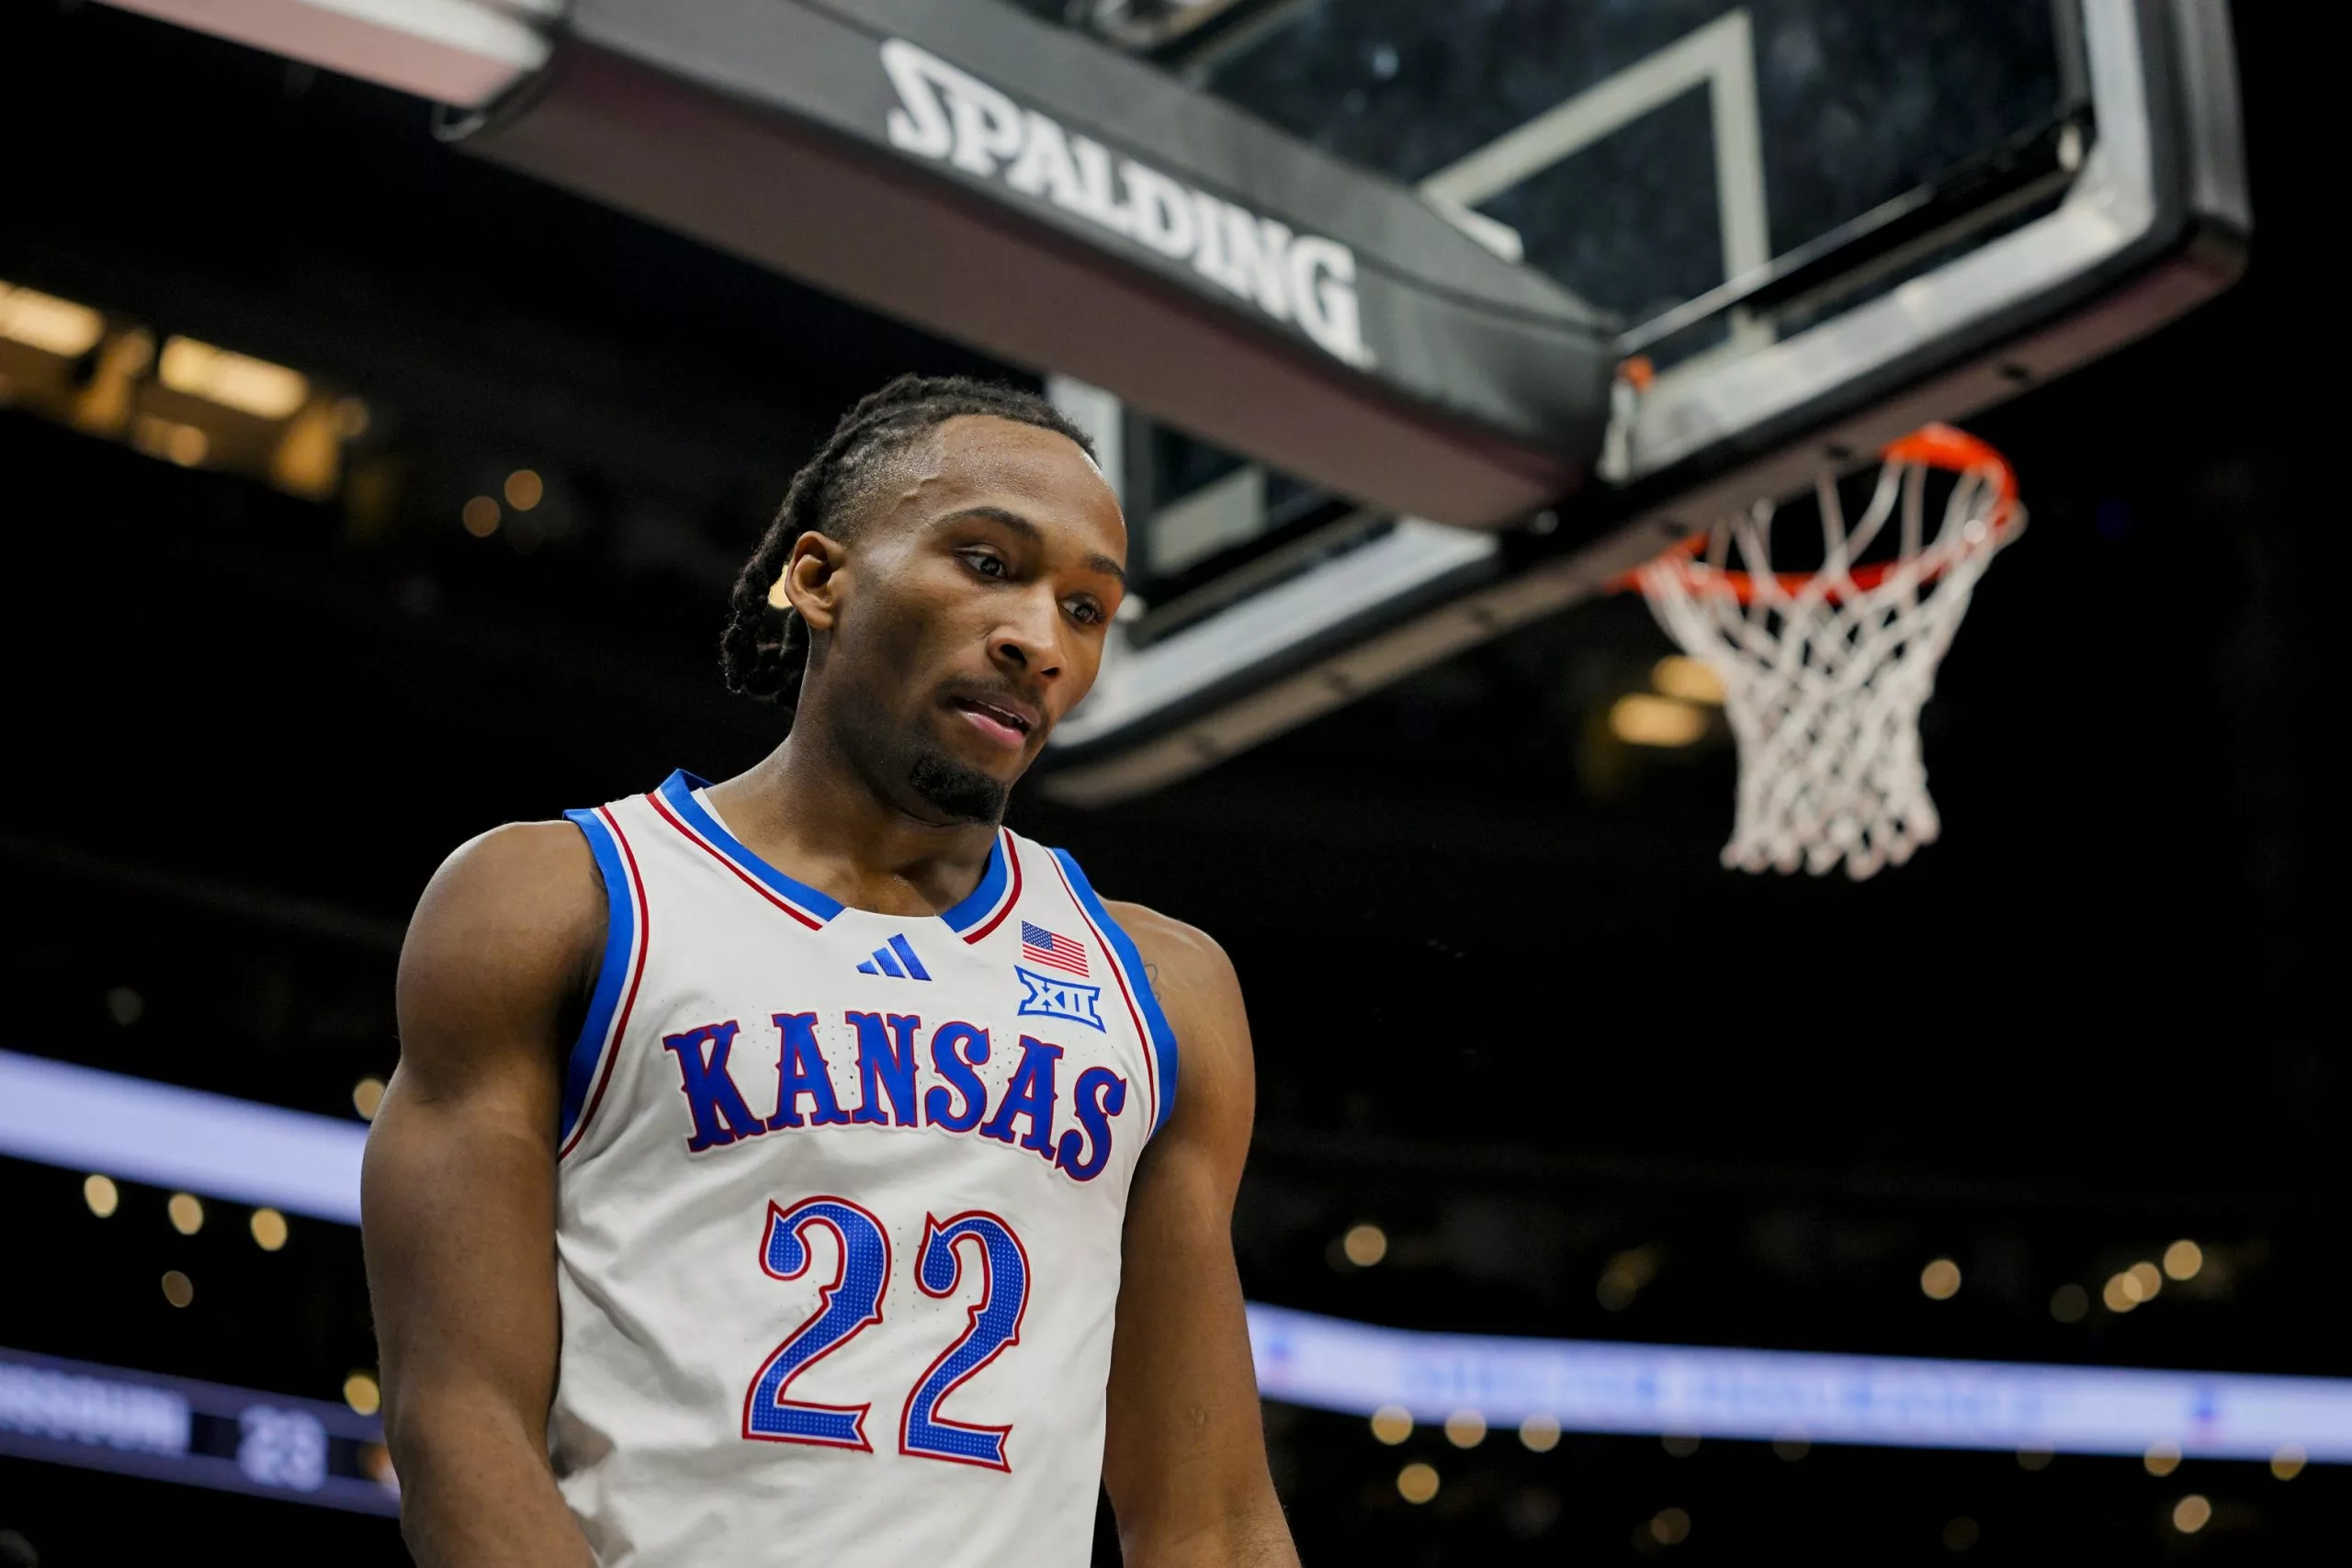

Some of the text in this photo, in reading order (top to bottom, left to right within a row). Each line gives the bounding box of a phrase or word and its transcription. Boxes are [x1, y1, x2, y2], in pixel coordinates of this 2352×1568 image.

[880, 38, 1375, 367] SPALDING
[662, 1011, 1127, 1182] KANSAS
[1013, 964, 1106, 1033] XII
[742, 1195, 1031, 1472] 22
